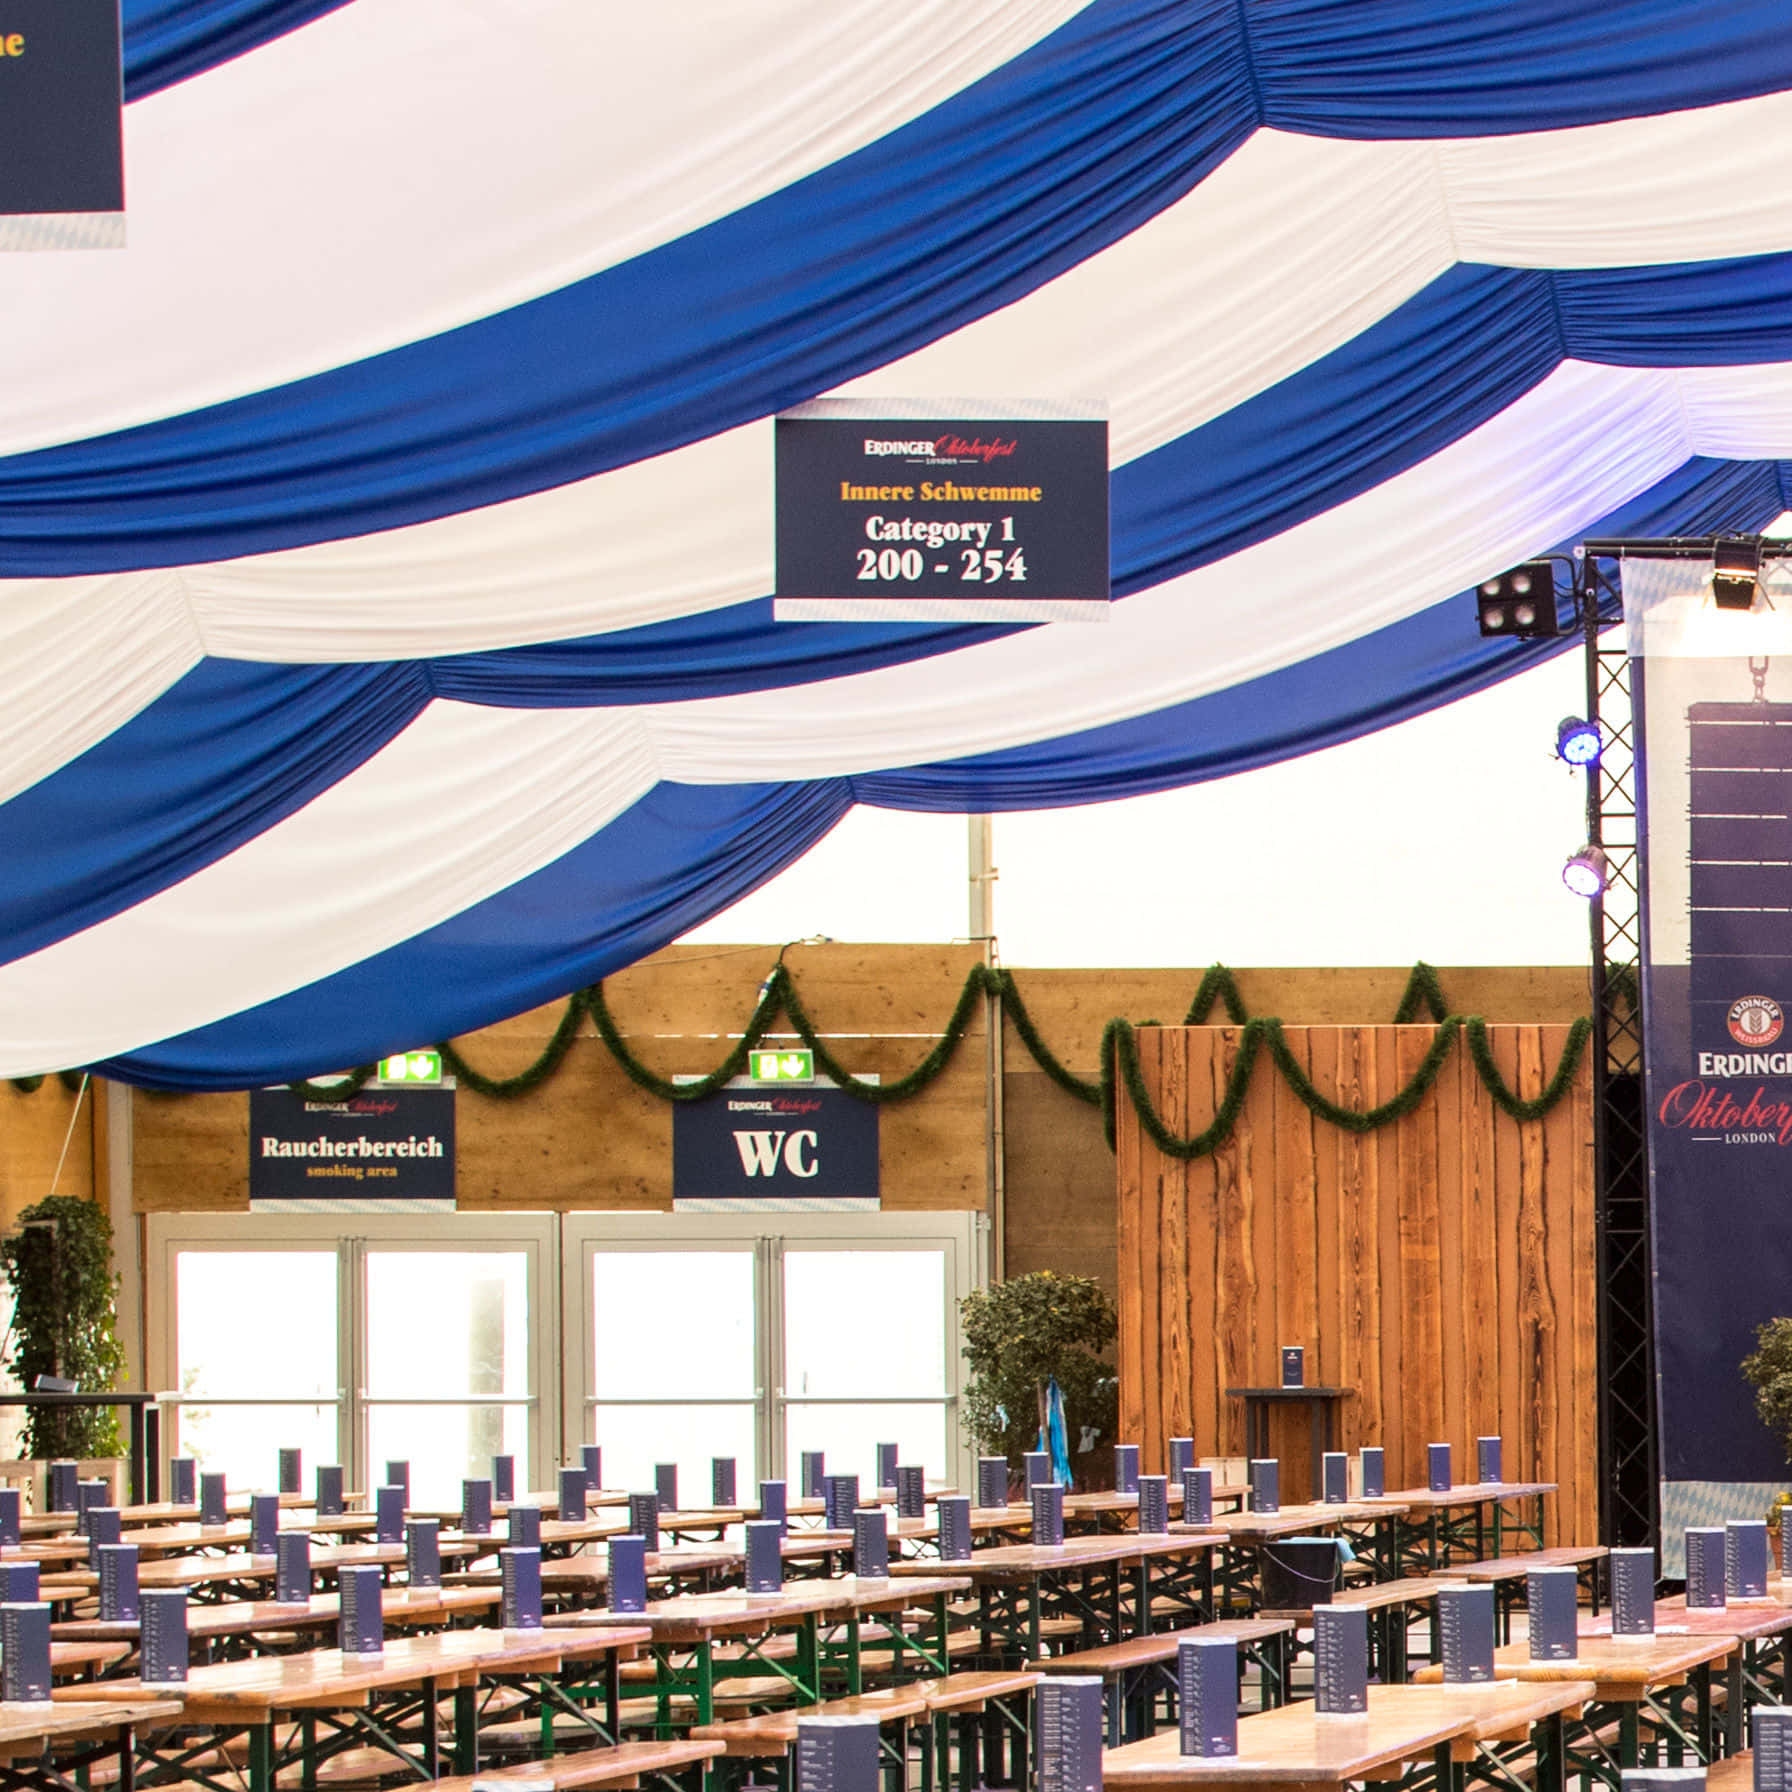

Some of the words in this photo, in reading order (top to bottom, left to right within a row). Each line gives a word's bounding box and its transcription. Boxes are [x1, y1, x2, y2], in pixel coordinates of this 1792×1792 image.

[864, 439, 936, 456] ERDINGER
[933, 434, 1017, 464] Oktoberfest
[840, 481, 914, 501] Innere
[920, 481, 1042, 502] Schwemme
[865, 516, 992, 549] Category
[1000, 516, 1015, 542] 1
[856, 549, 925, 582] 200
[934, 563, 950, 574] -
[960, 547, 1028, 584] 254
[1731, 998, 1780, 1020] ERDINGER
[261, 1136, 444, 1158] Raucherbereich
[1725, 1132, 1776, 1145] LONDON
[732, 1130, 819, 1178] WC
[306, 1163, 364, 1180] smoking
[366, 1166, 398, 1177] area
